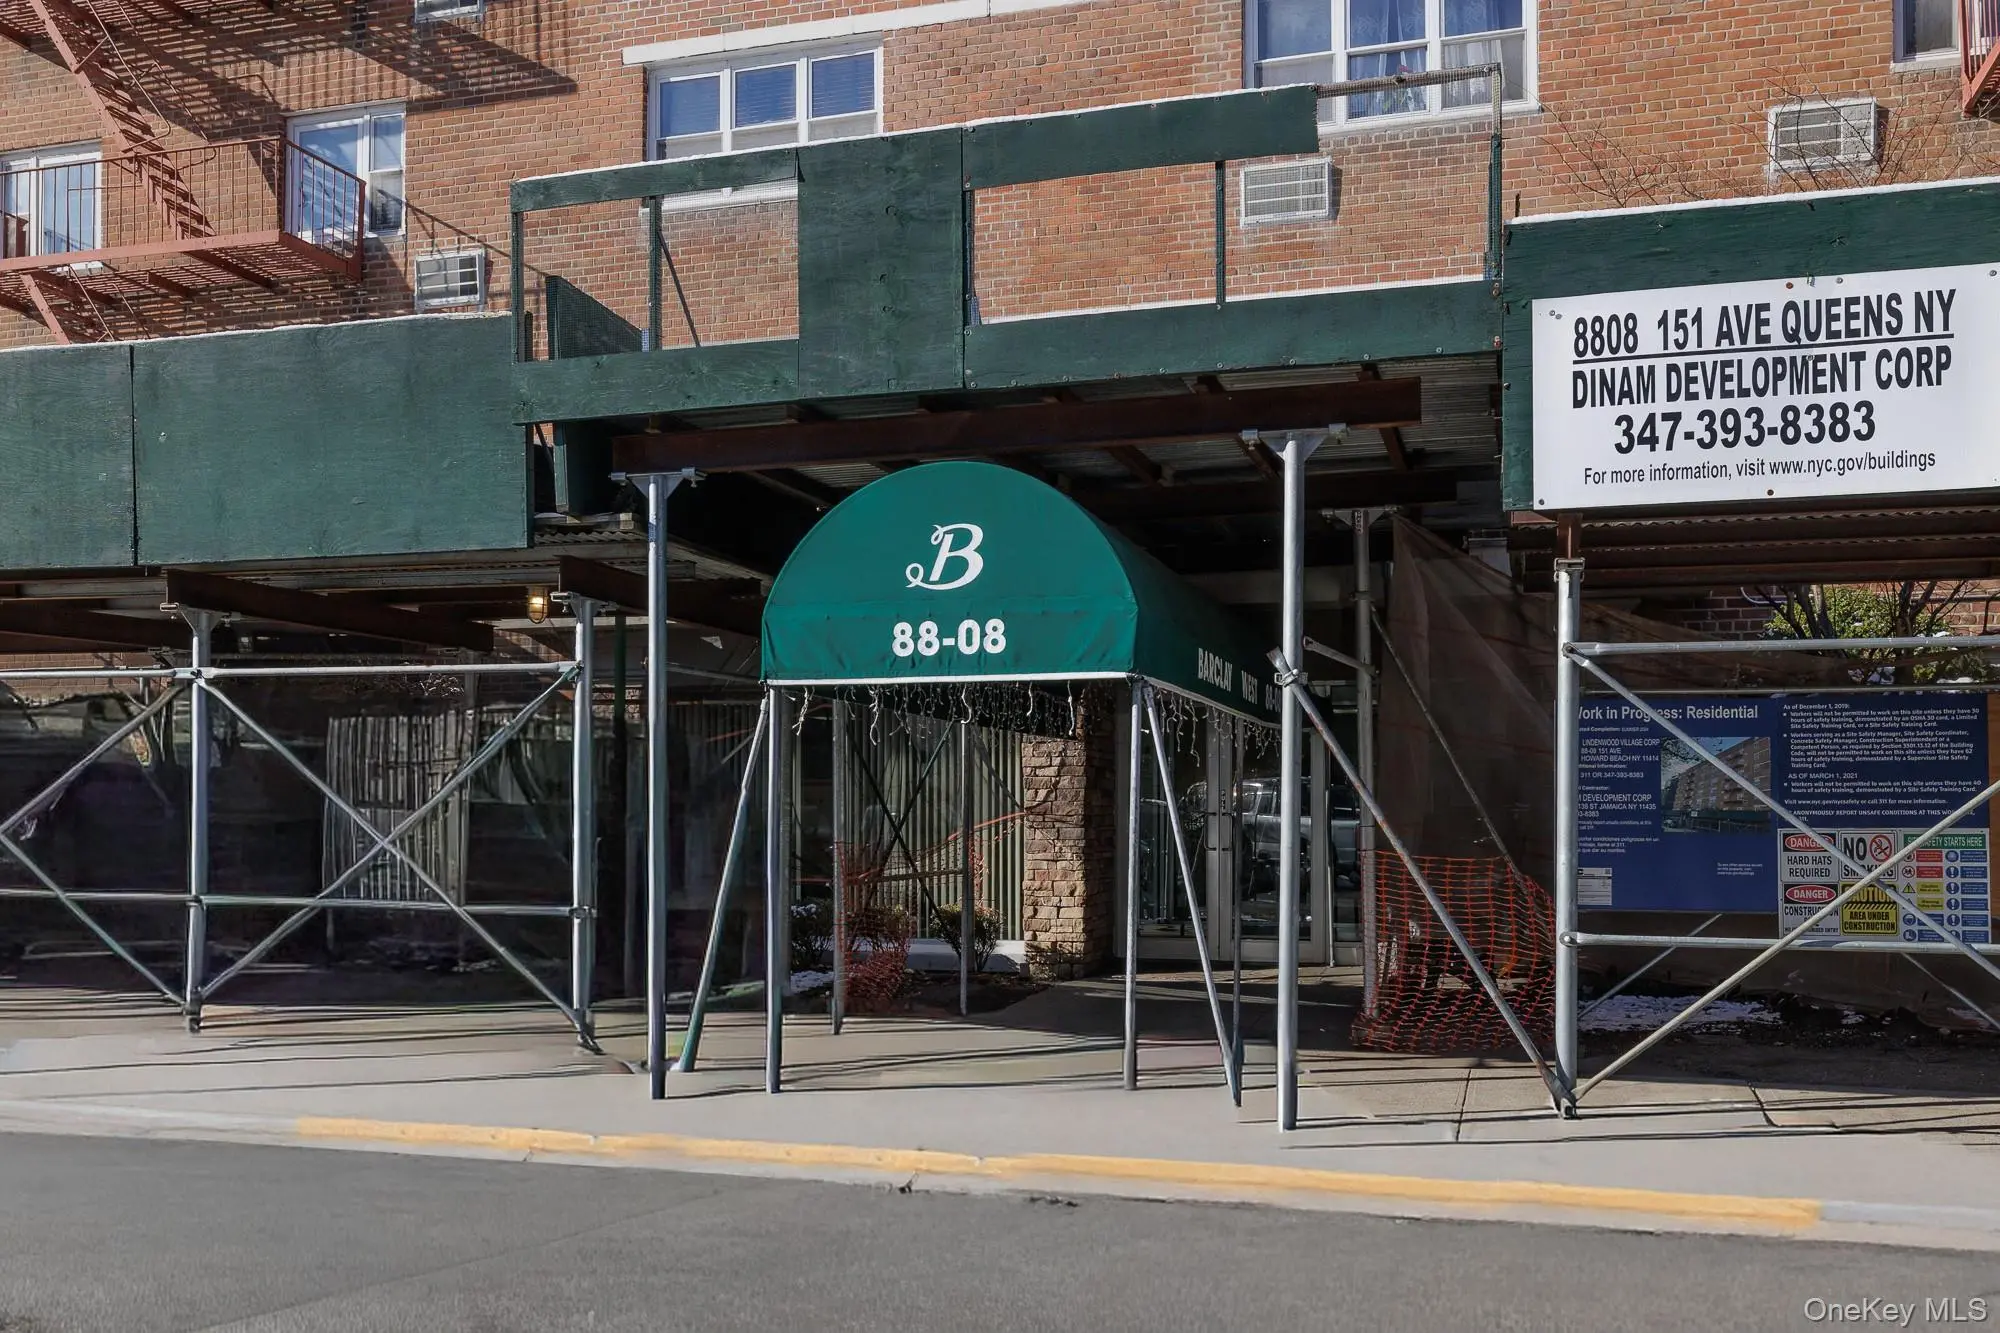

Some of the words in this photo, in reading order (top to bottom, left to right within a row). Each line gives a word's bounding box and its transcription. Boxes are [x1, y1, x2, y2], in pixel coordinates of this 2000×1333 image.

[1574, 312, 1638, 358] 8808
[1657, 306, 1703, 351] 151
[1715, 303, 1772, 347] AVE
[1781, 292, 1904, 345] QUEENS
[1914, 288, 1957, 333] NY
[1572, 364, 1656, 409] DINAM
[1666, 351, 1867, 403] DEVELOPMENT
[1875, 345, 1952, 390] CORP
[1614, 400, 1876, 455] 347-393-8383
[1584, 467, 1607, 485] For
[1611, 467, 1645, 484] more
[1649, 461, 1732, 482] information,
[1736, 458, 1765, 477] visit
[1769, 450, 1936, 477] www.nyc.gov/buildings
[905, 523, 984, 590] B
[892, 618, 1007, 657] 88-08
[1198, 647, 1233, 692] BARCLAY
[1241, 670, 1258, 705] WEST
[1606, 706, 1617, 719] in
[1622, 705, 1682, 722] Progess:
[1686, 705, 1758, 719] Residential
[1582, 794, 1632, 802] DEVELOPMENT
[1632, 794, 1652, 802] CORP
[1790, 837, 1821, 848] DANG
[1843, 837, 1867, 861] NO
[1944, 837, 1966, 847] STARTS
[1967, 836, 1983, 846] HERE
[1787, 856, 1809, 865] HARD
[1810, 856, 1832, 865] HATS
[1789, 867, 1831, 878] REQUIRED
[1793, 889, 1828, 899] DANGER
[1849, 911, 1867, 920] AREA
[1867, 911, 1890, 920] UNDER
[1844, 921, 1896, 931] CONSTRUCTION
